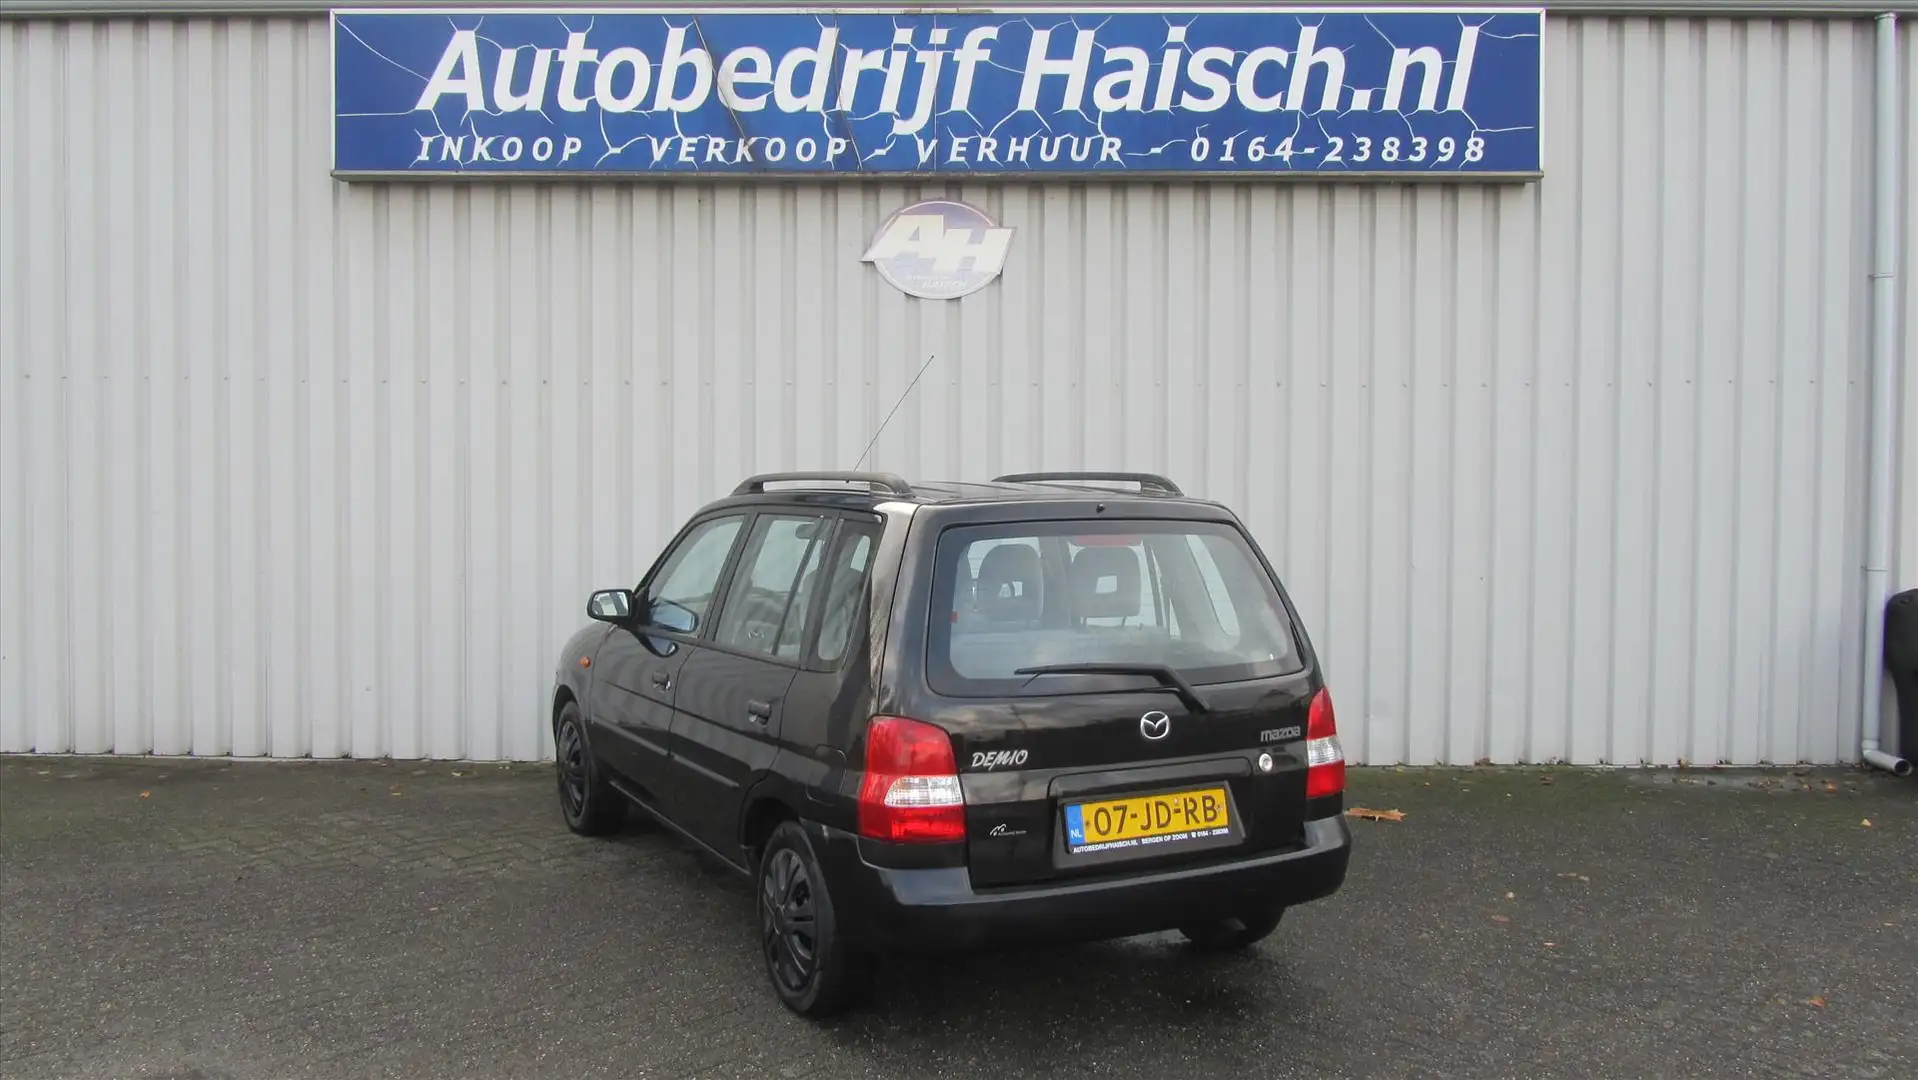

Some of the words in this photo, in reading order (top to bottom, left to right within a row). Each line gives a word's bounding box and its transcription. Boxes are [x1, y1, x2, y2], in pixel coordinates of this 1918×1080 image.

[415, 26, 999, 136] Autobedrijf
[1017, 26, 1479, 112] Haisch.nl
[417, 136, 583, 162] INKOOP
[651, 136, 847, 162] VERKOOP
[917, 136, 1122, 162] VERHUUR
[1190, 136, 1485, 162] 0164-238398
[861, 214, 1013, 274] AH
[971, 749, 1029, 771] DEMIO
[1093, 795, 1218, 836] 07-JD-RB
[1070, 828, 1082, 839] NL
